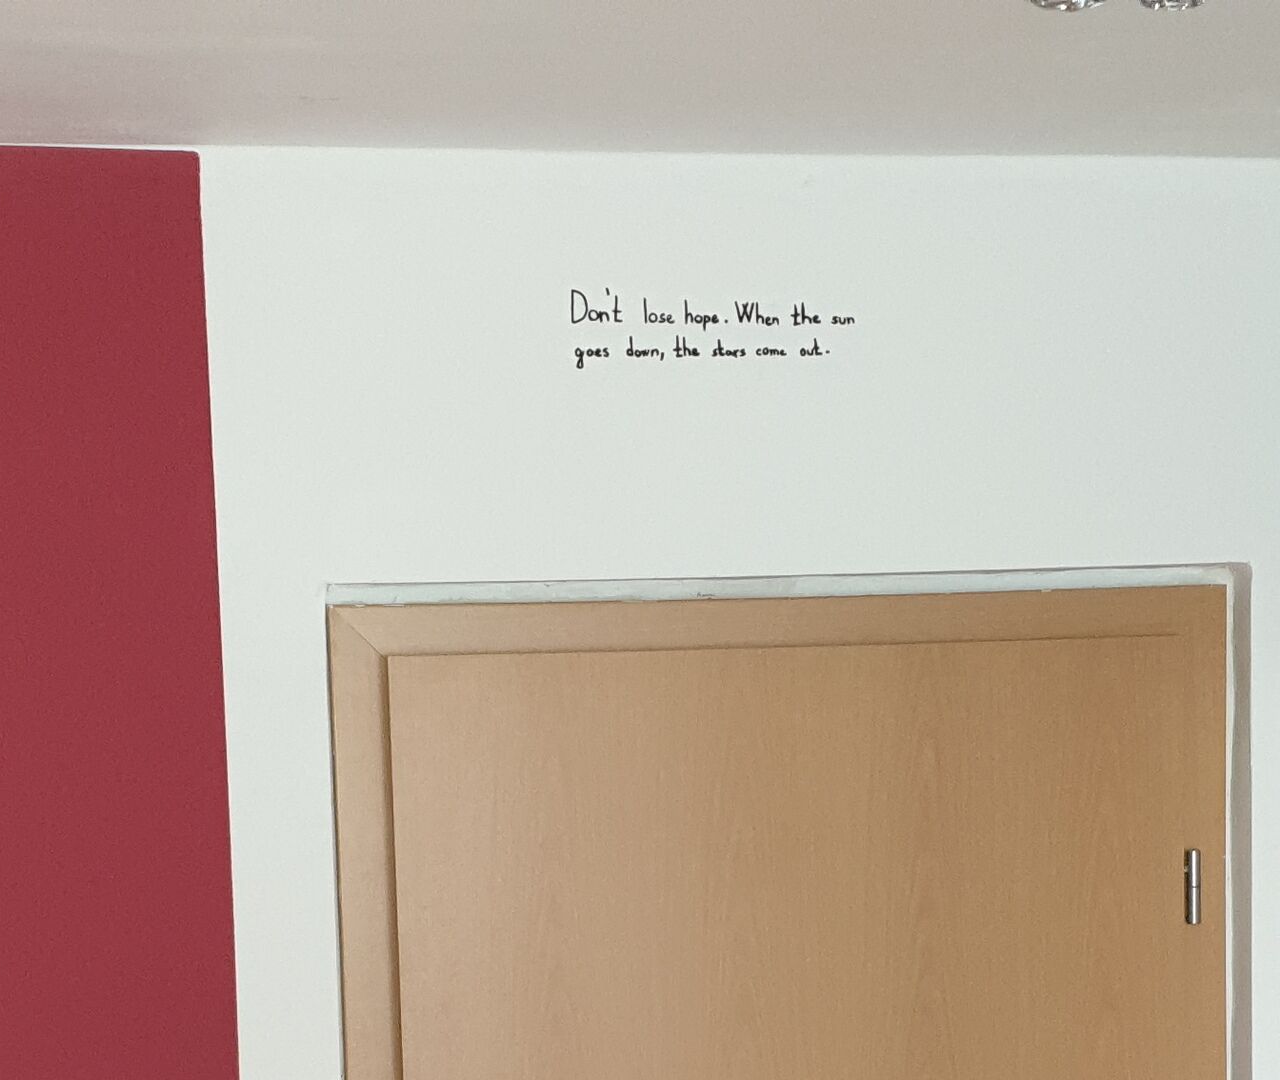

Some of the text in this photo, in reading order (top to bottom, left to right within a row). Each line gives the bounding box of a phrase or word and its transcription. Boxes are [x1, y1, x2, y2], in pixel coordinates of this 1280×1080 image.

[570, 287, 856, 331] Don't lose hope. When the sun
[574, 335, 830, 370] goes down, the stars come out.
